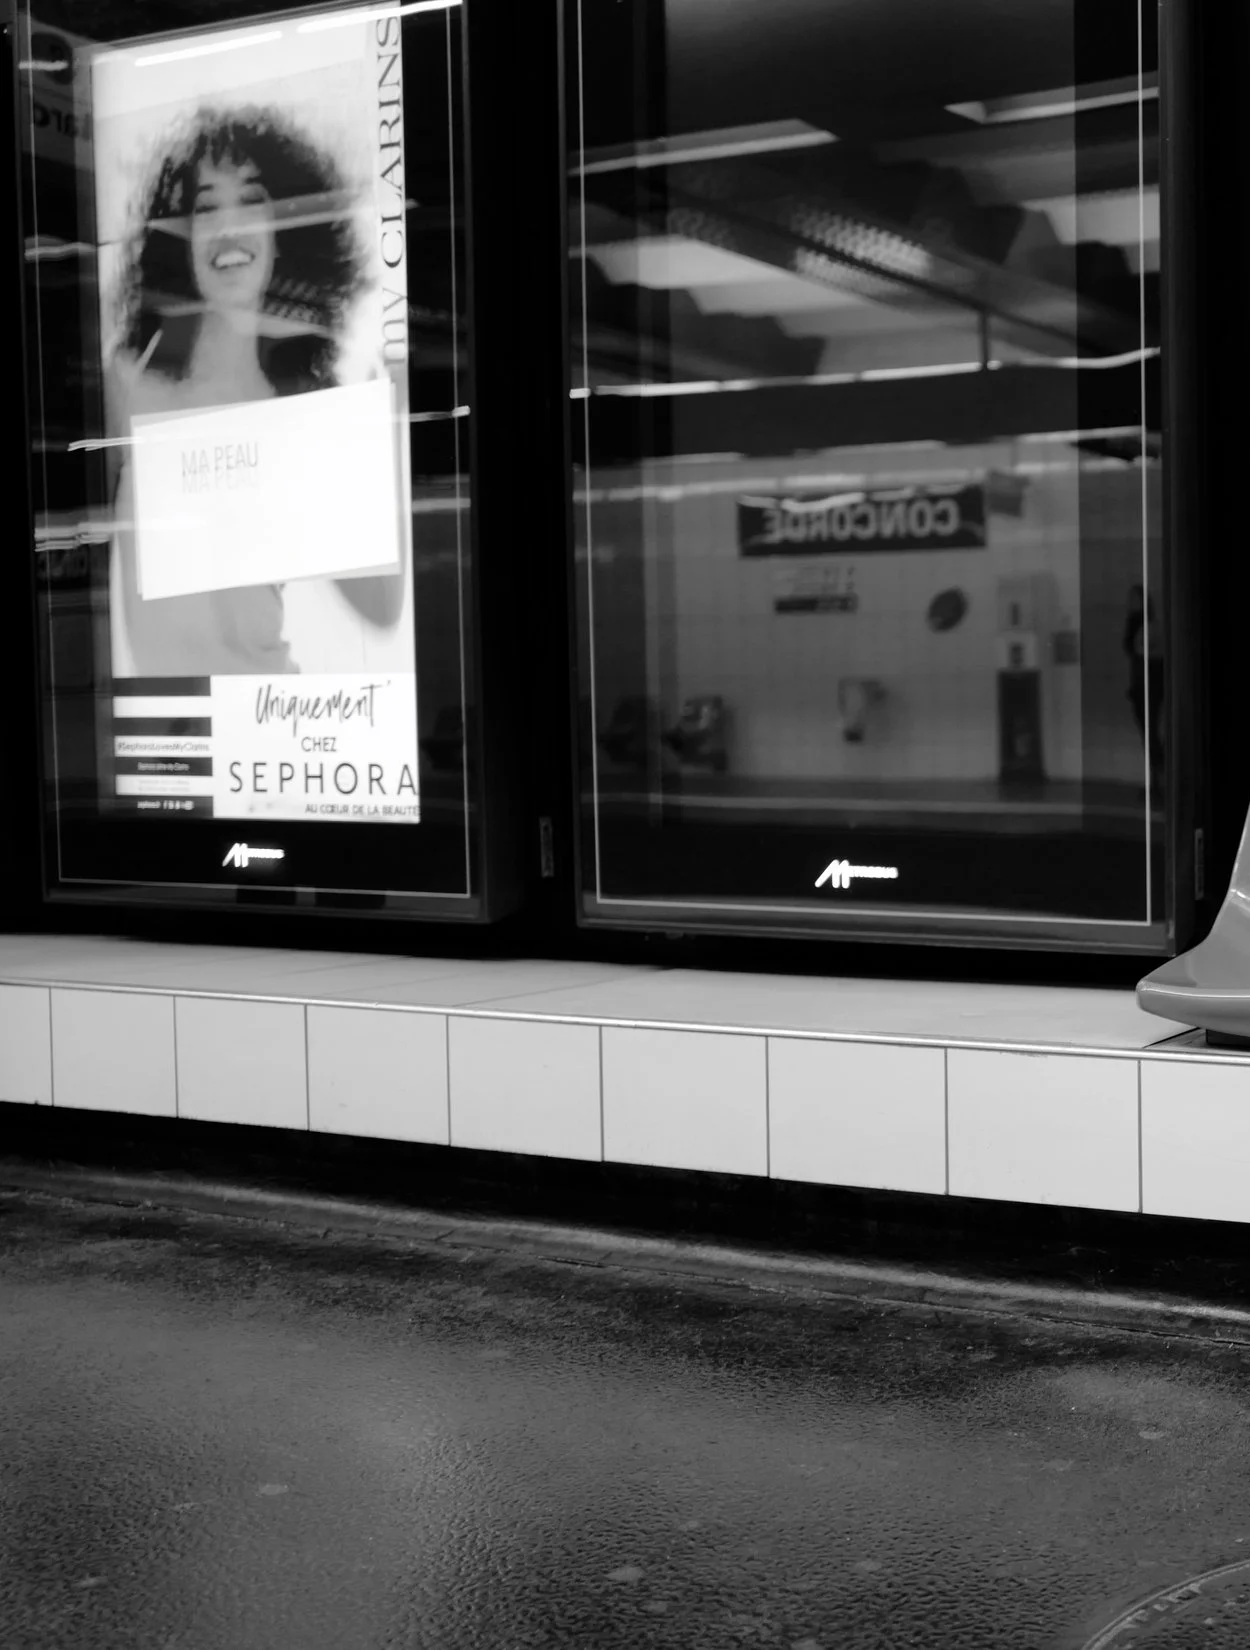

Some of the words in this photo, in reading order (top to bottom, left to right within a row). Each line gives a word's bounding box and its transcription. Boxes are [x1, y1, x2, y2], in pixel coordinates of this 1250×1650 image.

[376, 15, 404, 269] CLARINS
[214, 441, 258, 470] PEAU
[301, 736, 337, 752] CHEZ
[229, 761, 418, 796] SEPHORA
[305, 803, 318, 814] AU
[352, 804, 364, 816] DE
[367, 805, 380, 816] LA
